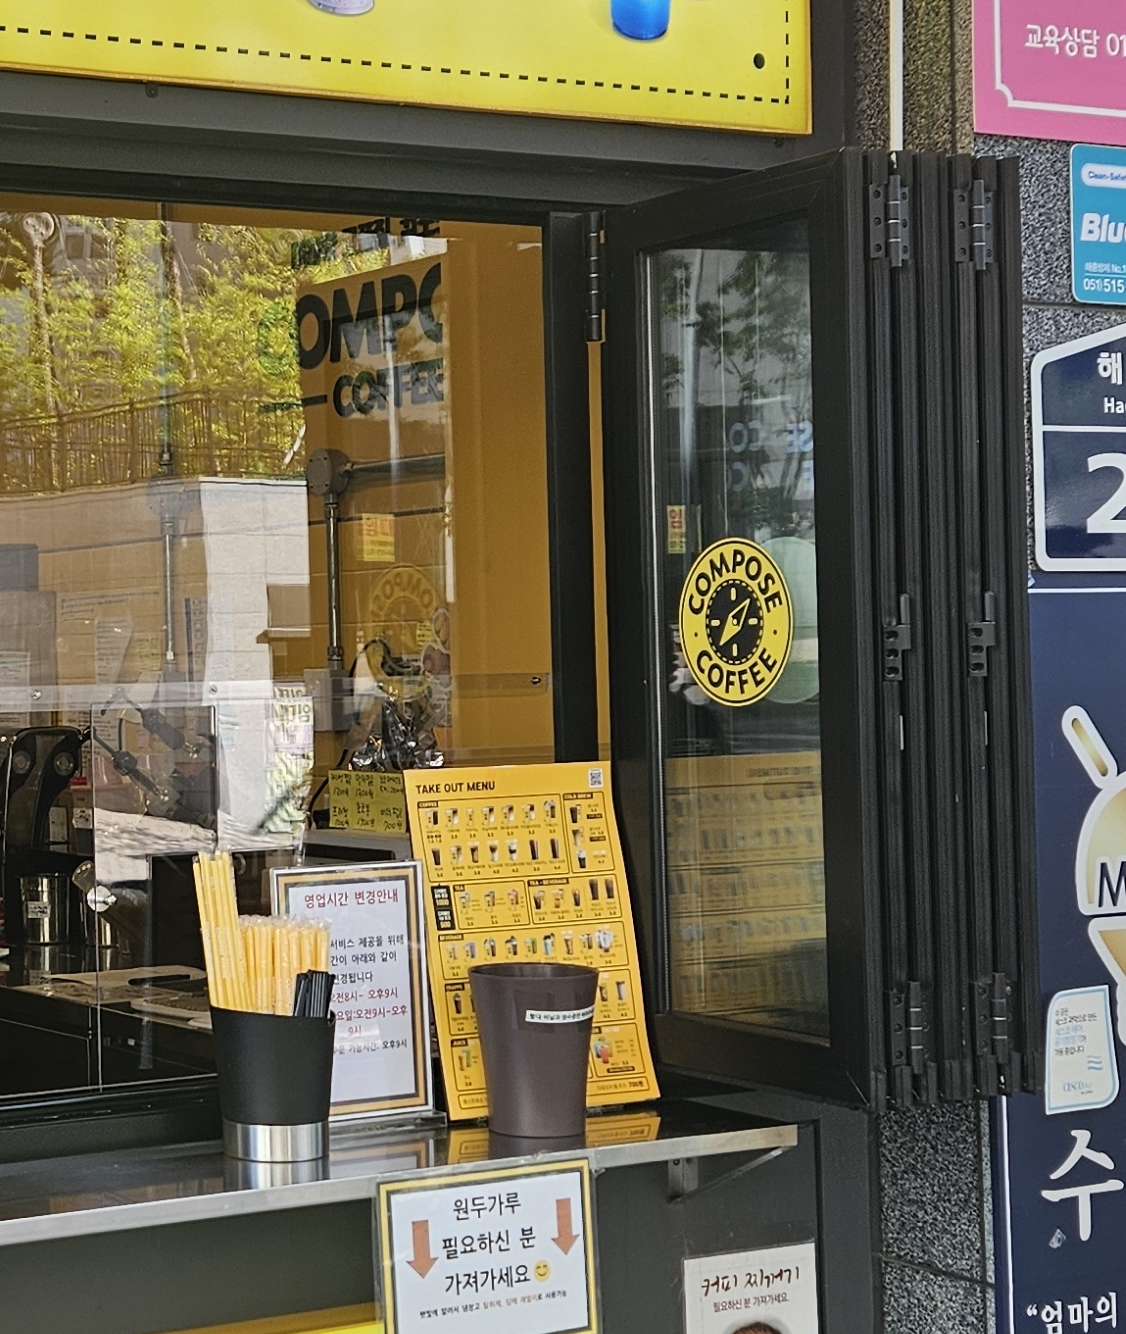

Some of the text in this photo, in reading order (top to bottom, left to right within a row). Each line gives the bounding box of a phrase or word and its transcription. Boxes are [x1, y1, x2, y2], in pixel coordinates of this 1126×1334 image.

[1025, 24, 1100, 58] 교육상담
[1080, 212, 1126, 244] Blu
[1098, 351, 1122, 385] 해
[689, 549, 784, 616] COMPOSE
[696, 647, 778, 696] COFFEE
[416, 780, 496, 795] TAKE OUT MENU
[304, 888, 399, 909] 영업시간 변경안내
[330, 933, 405, 950] 서비스 제공을 위해
[351, 952, 376, 965] 아래와
[380, 950, 398, 963] 같이
[368, 987, 399, 999] 오후9시
[347, 1025, 362, 1036] 9시
[382, 1038, 408, 1050] 오후9시
[1041, 1129, 1125, 1242] 수
[453, 1191, 522, 1222] 원두가루
[441, 1225, 537, 1261] 필요하신 분
[444, 1263, 532, 1297] 가져가세요
[700, 1265, 800, 1297] 커피 찌꺼기
[713, 1297, 743, 1313] 필요하신
[744, 1297, 752, 1308] 분
